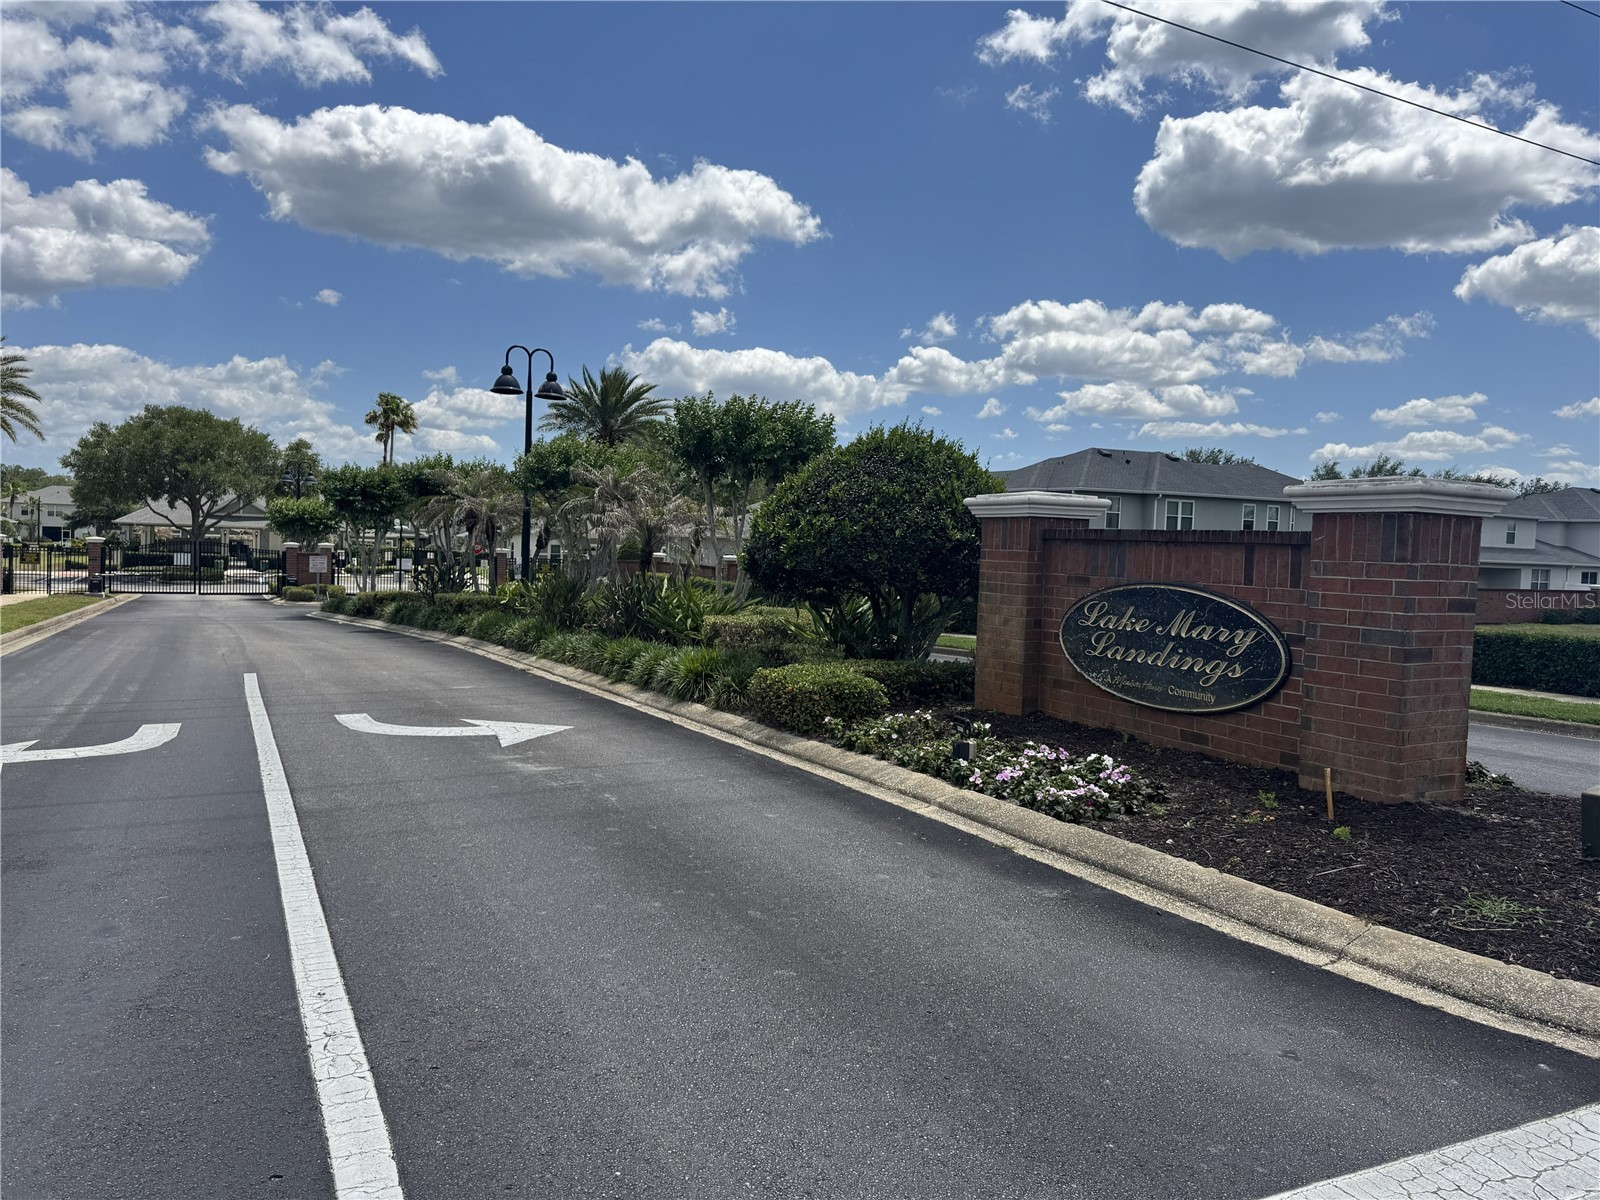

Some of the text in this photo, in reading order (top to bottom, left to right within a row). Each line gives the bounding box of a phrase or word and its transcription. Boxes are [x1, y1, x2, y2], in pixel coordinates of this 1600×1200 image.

[1077, 600, 1267, 658] Lake Mary
[1085, 630, 1253, 687] Landings
[1168, 685, 1216, 704] Community
